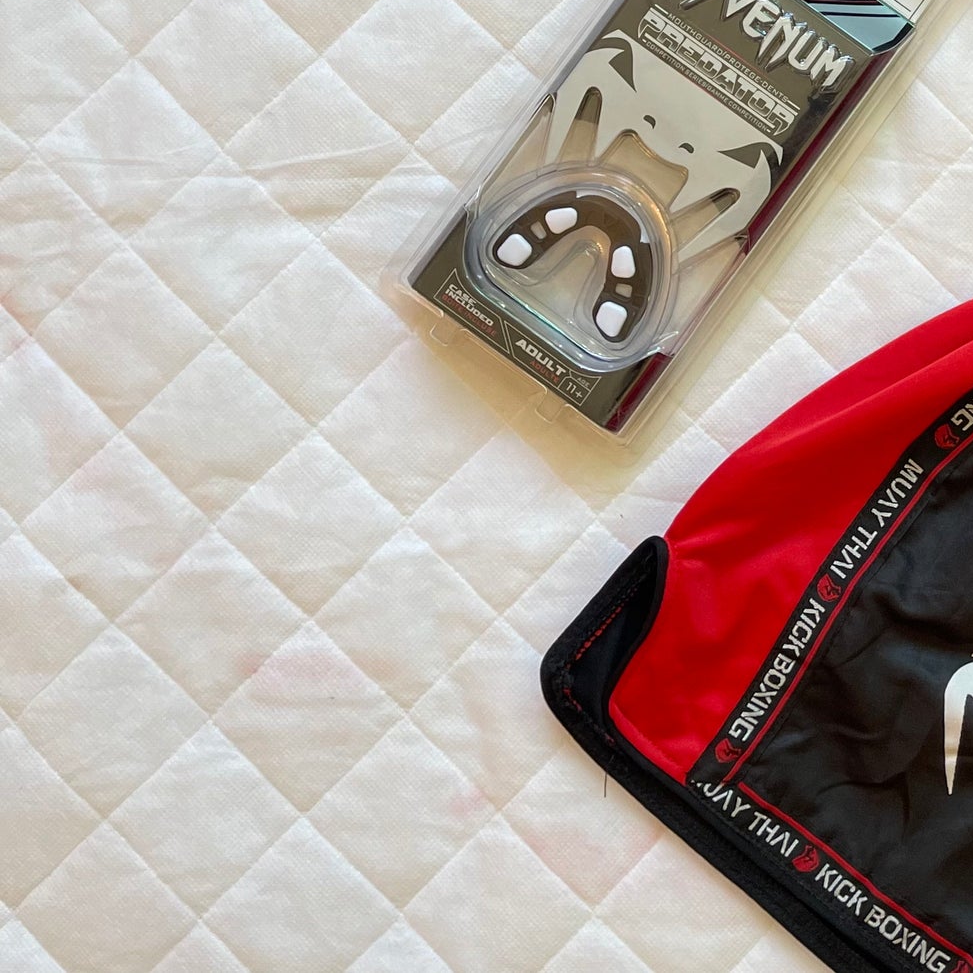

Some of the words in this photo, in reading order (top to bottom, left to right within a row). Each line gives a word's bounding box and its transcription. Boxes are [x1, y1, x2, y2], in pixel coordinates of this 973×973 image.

[637, 8, 796, 136] PREDATOR
[645, 40, 685, 73] COMPETITION
[727, 98, 768, 132] COMPETITION
[445, 288, 494, 327] INCLUDED
[448, 283, 478, 305] CASE
[515, 338, 567, 377] ADULT
[566, 382, 583, 399] 11+
[870, 458, 925, 528] MUAY
[829, 526, 878, 579] THAI
[781, 597, 826, 658] KICK
[728, 652, 796, 742] BOXING
[690, 779, 752, 818] UAY
[748, 811, 800, 858] THAI
[814, 863, 869, 917] KICK
[863, 903, 951, 973] BOXING
